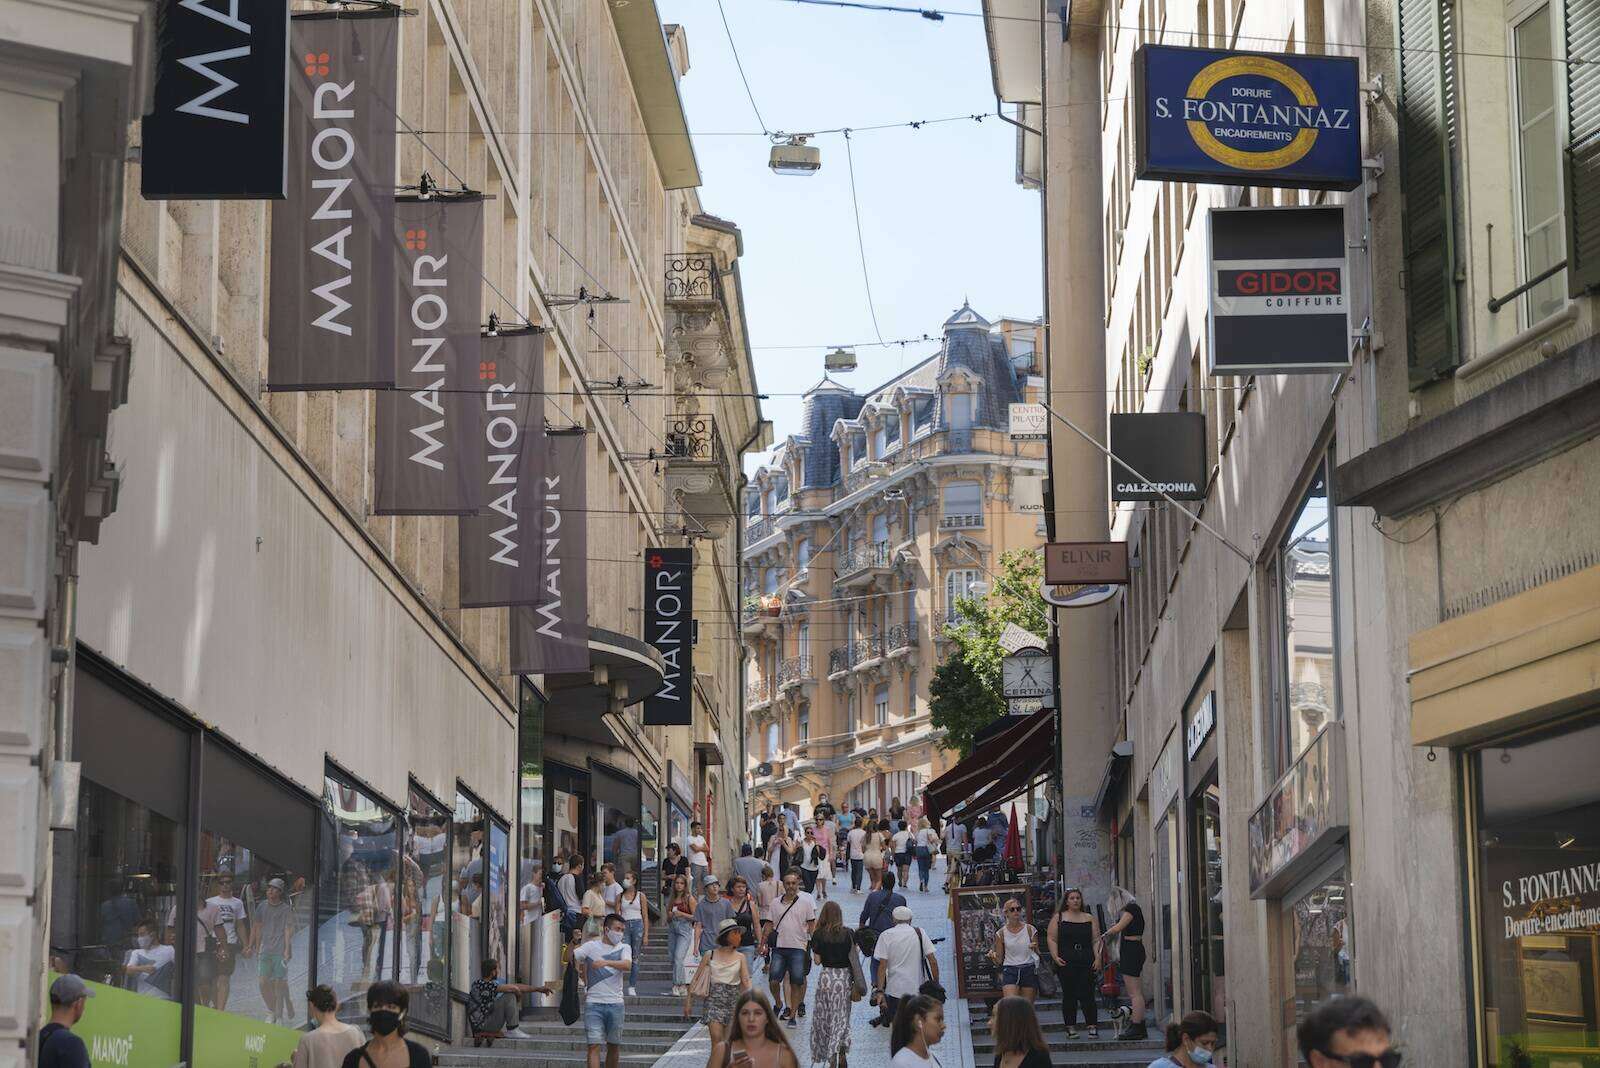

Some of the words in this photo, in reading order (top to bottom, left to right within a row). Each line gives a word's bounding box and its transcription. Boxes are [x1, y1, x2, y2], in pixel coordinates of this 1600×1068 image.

[1232, 87, 1272, 99] DORURE
[1155, 97, 1173, 118] S.
[1183, 98, 1351, 130] FONTANNAZ
[1214, 127, 1293, 142] ENCADREMENTS
[310, 80, 355, 336] MANOR
[1235, 271, 1339, 294] GIDOR
[1266, 296, 1342, 307] COIFFURE
[408, 253, 448, 471] MANOR
[1012, 415, 1046, 423] PILATES
[485, 381, 520, 568] MANOR
[1061, 549, 1112, 564] ELIXIR
[654, 570, 682, 702] MANOR
[1004, 688, 1052, 696] CERTINA
[1503, 880, 1516, 908] S.
[92, 1033, 128, 1065] MANOR
